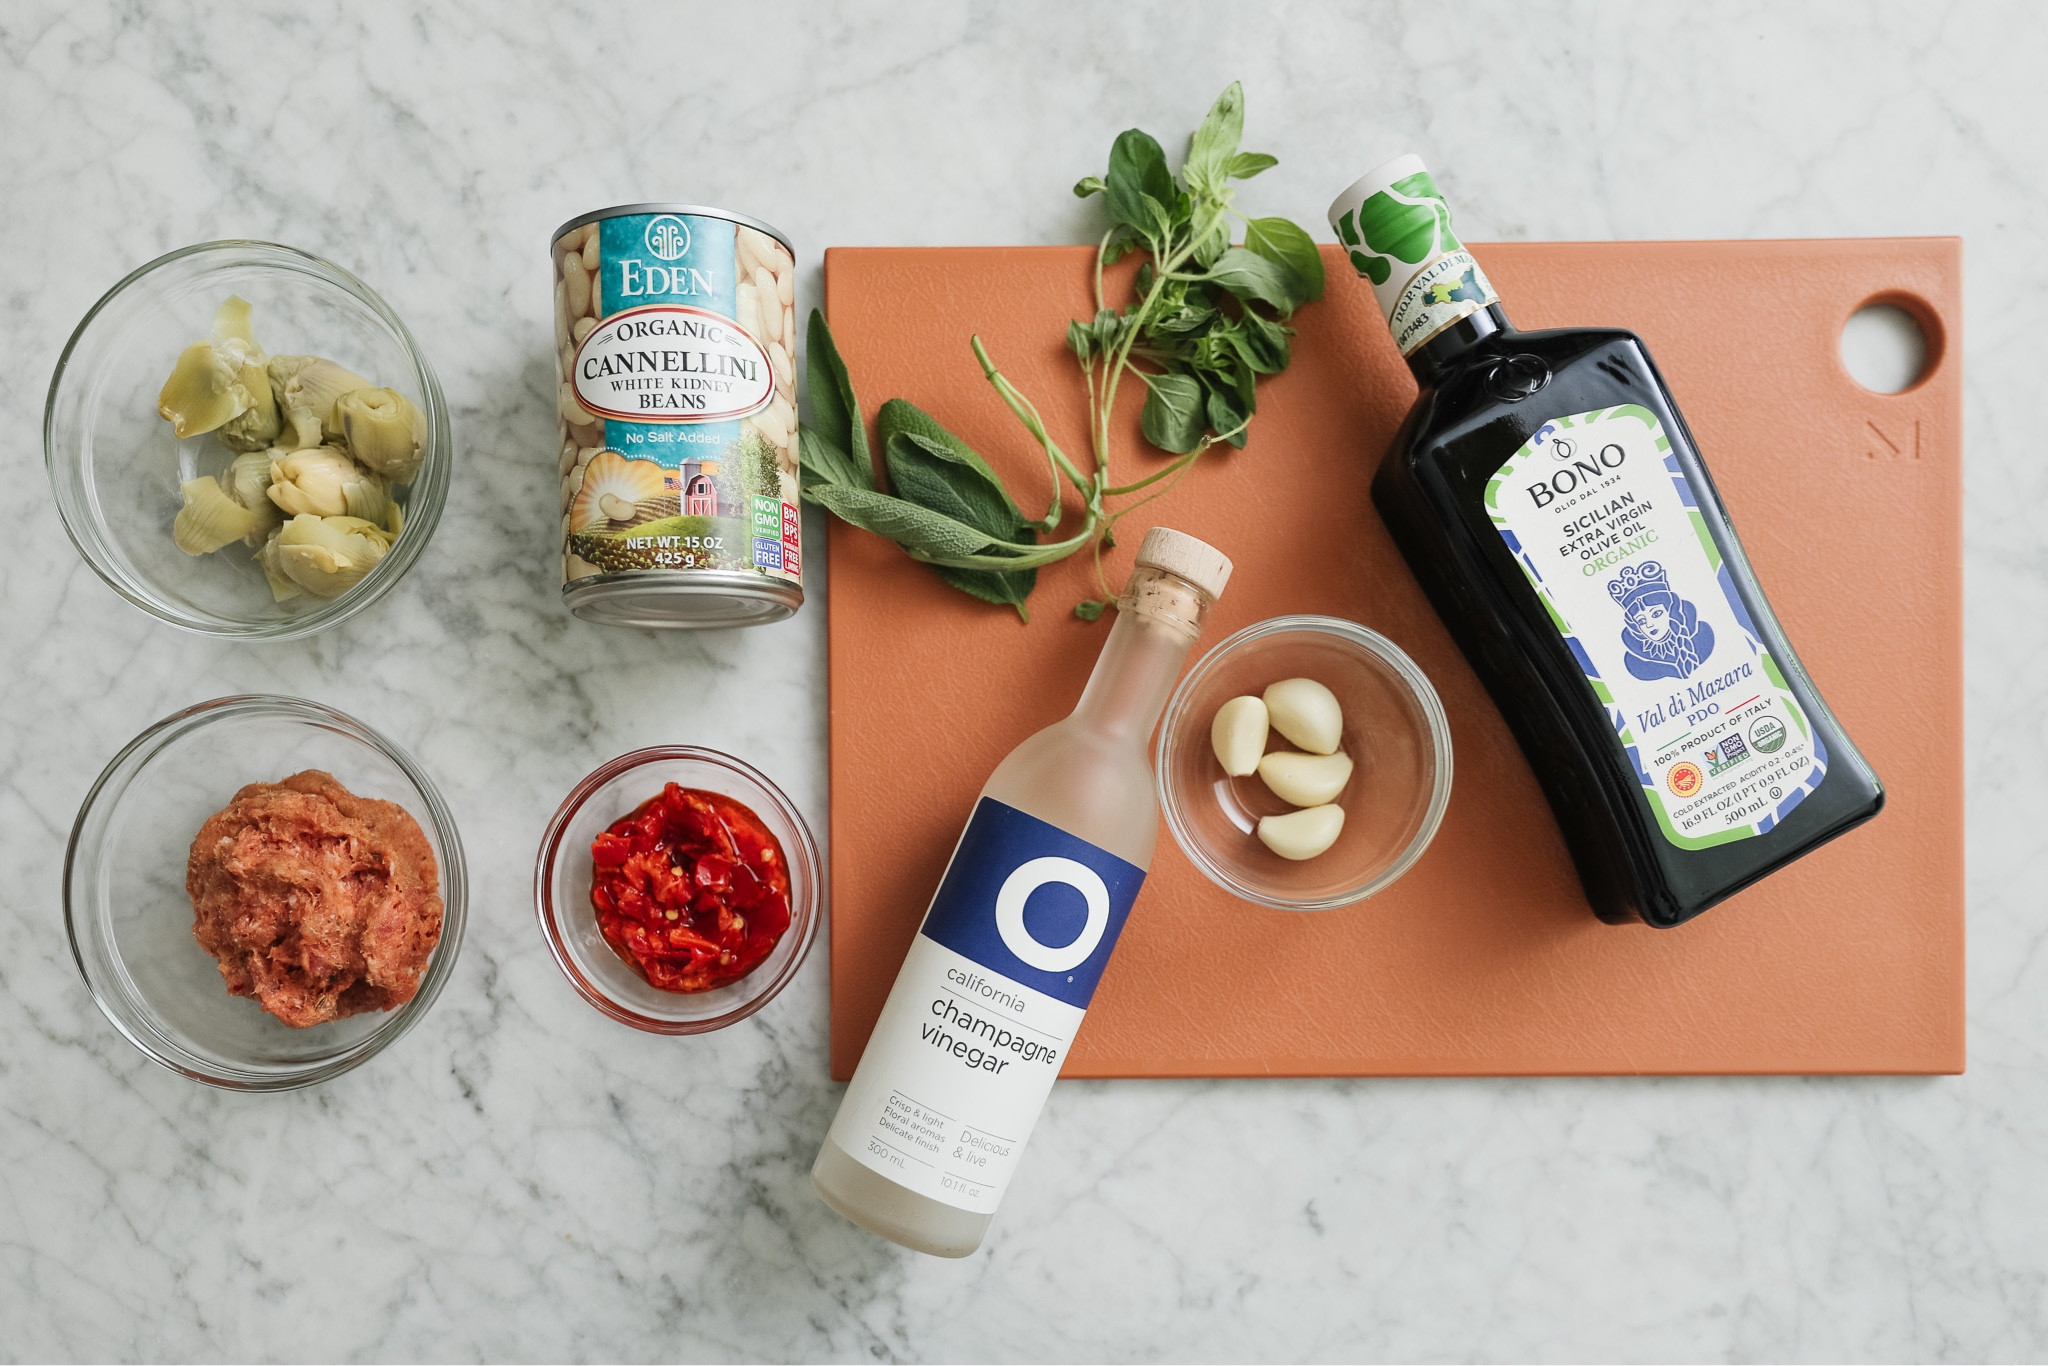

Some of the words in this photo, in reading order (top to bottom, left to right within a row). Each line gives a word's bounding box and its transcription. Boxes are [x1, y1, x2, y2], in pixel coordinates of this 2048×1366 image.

[619, 259, 714, 297] EDEN
[1413, 270, 1439, 292] VAL
[1438, 258, 1454, 272] DI
[616, 319, 722, 343] ORGANIC
[583, 350, 758, 382] CANNELLINI
[611, 377, 664, 393] WHITE
[671, 377, 733, 394] KIDNEY
[639, 393, 706, 410] BEANS
[626, 432, 643, 444] No
[647, 431, 673, 443] Salt
[679, 432, 721, 444] Added
[1526, 443, 1626, 509] BONO
[755, 499, 778, 515] NON
[1554, 498, 1577, 514] OLIO
[1579, 488, 1598, 501] DAL
[1600, 474, 1621, 489] 1934
[755, 512, 779, 528] GMO
[783, 506, 798, 524] BPA
[1563, 491, 1635, 538] SICILIAN
[755, 527, 779, 537] VERIFIED
[784, 522, 798, 539] BPS
[1559, 527, 1605, 557] EXTRA
[1605, 500, 1653, 531] VIRGIN
[1580, 533, 1621, 560] OLIVE
[1623, 521, 1646, 538] OIL
[626, 536, 654, 550] NET
[657, 535, 680, 549] WT
[684, 536, 700, 549] 15
[703, 536, 724, 550] OZ
[755, 541, 780, 553] GLUTEN
[1582, 529, 1659, 577] ORGANIC
[654, 552, 682, 565] 425
[685, 554, 695, 568] g
[756, 551, 780, 567] FREE
[784, 549, 799, 565] FREE
[1637, 703, 1666, 733] Val
[1668, 692, 1686, 718] di
[1687, 662, 1753, 707] Mazara
[1686, 702, 1720, 727] PDO
[1653, 749, 1680, 767] 100%
[1680, 723, 1726, 753] PRODUCT
[1729, 714, 1742, 726] OF
[1744, 698, 1772, 717] ITALY
[1721, 734, 1740, 748] NON
[1754, 722, 1776, 737] USDA
[1724, 741, 1743, 754] GMO
[1711, 752, 1749, 774] VERIFIED
[1673, 804, 1694, 819] COLD
[1694, 781, 1737, 808] EXTRACTED
[1740, 765, 1768, 783] ACIDITY
[1768, 757, 1780, 767] 0.2
[1682, 814, 1702, 830] 16.9
[1702, 807, 1718, 820] FL
[1716, 797, 1734, 811] OZ
[1741, 783, 1758, 797] PT
[1759, 775, 1775, 788] 0.9
[1775, 766, 1790, 780] FL
[1789, 755, 1810, 771] OZ)
[1725, 808, 1746, 825] 500
[1748, 797, 1769, 812] mL
[995, 856, 1110, 973] O
[947, 967, 1026, 1013] california
[931, 998, 1057, 1065] champagne
[921, 1022, 1009, 1076] vinegar
[884, 1105, 909, 1125] Floral
[910, 1120, 947, 1143] aromas
[889, 1095, 912, 1113] Crisp
[913, 1108, 920, 1118] &
[922, 1112, 945, 1129] light
[878, 1116, 914, 1141] Delicate
[914, 1134, 940, 1153] finish
[960, 1130, 1010, 1157] Delicious
[867, 1140, 889, 1159] 300
[889, 1152, 906, 1170] mL
[952, 1146, 964, 1158] &
[965, 1149, 987, 1167] live
[940, 1176, 958, 1190] 10.1
[968, 1188, 981, 1198] oz
